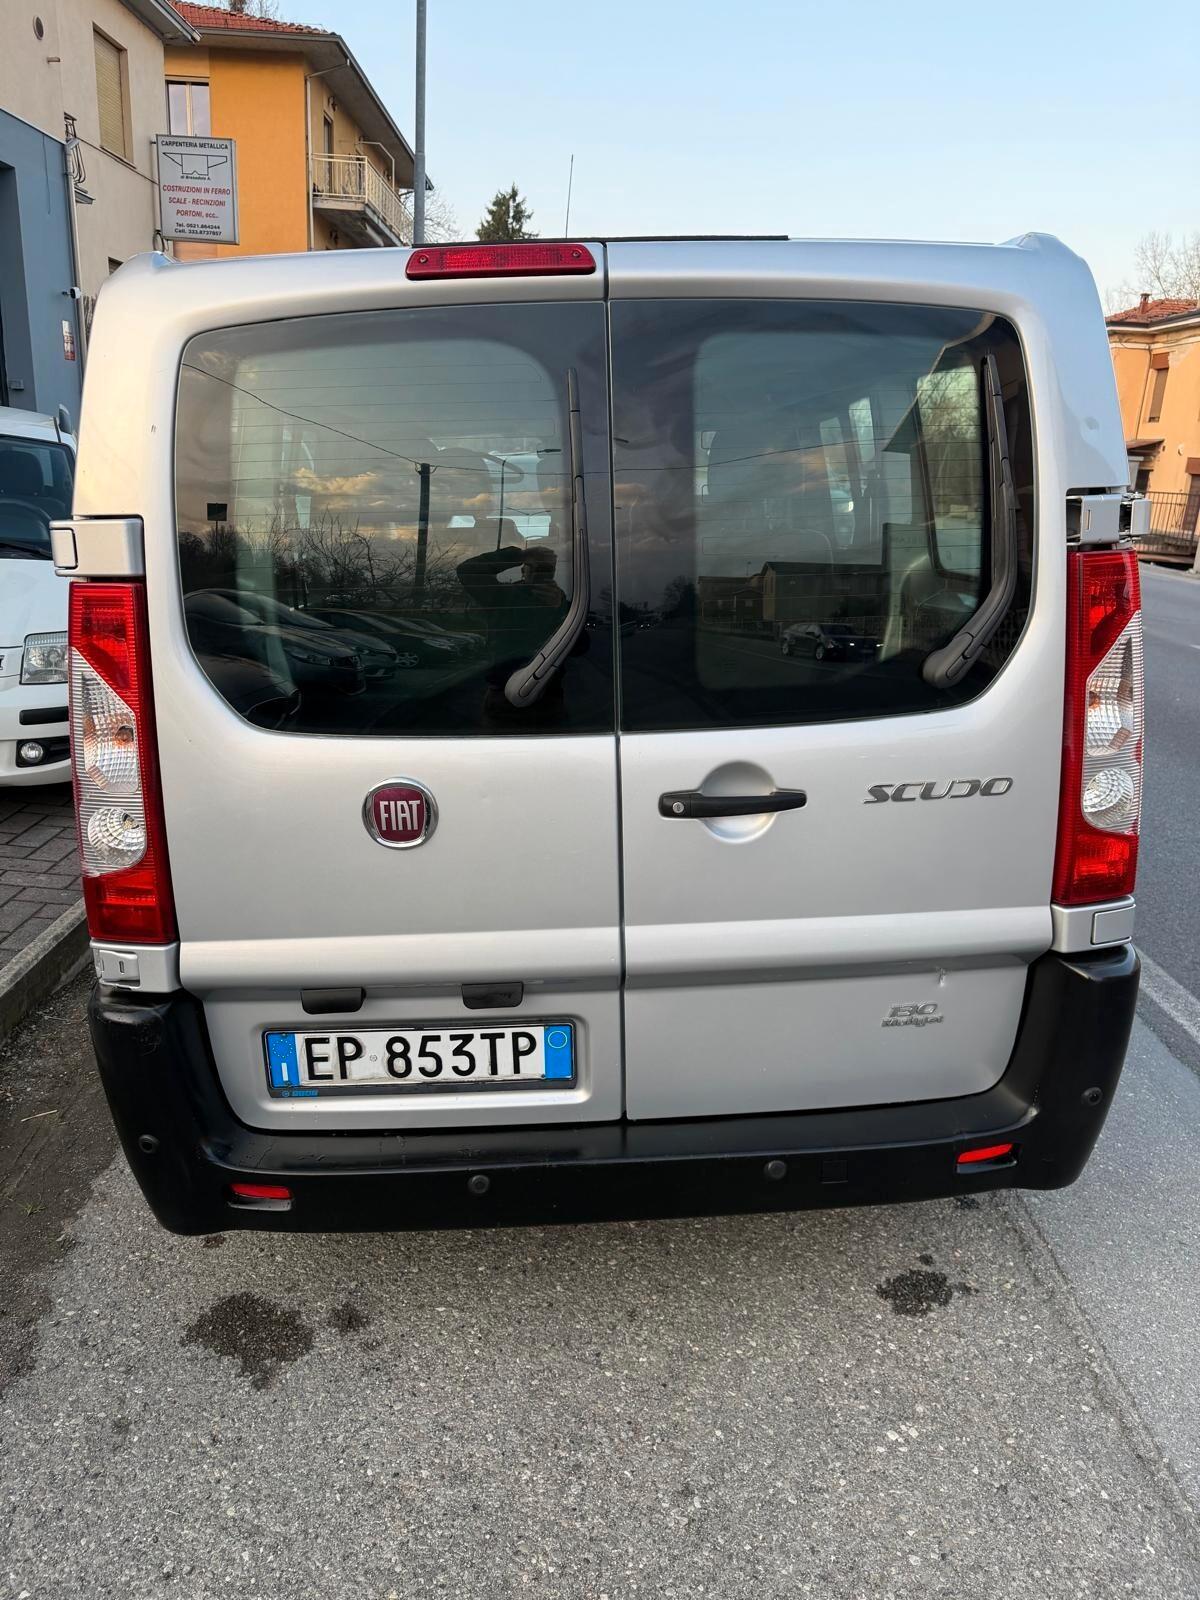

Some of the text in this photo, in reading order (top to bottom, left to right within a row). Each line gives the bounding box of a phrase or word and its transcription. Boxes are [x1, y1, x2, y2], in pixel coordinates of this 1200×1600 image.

[161, 140, 228, 150] CARPENTERIA METALLICA
[163, 184, 231, 196] COSTRUZIONI IN FERRO
[168, 197, 187, 205] SCALE
[192, 199, 226, 207] RECINZIONI
[176, 209, 204, 218] PORTONI,
[863, 777, 1014, 804] SCUDO
[379, 800, 421, 831] FIAT
[304, 1031, 537, 1081] EP 853TP
